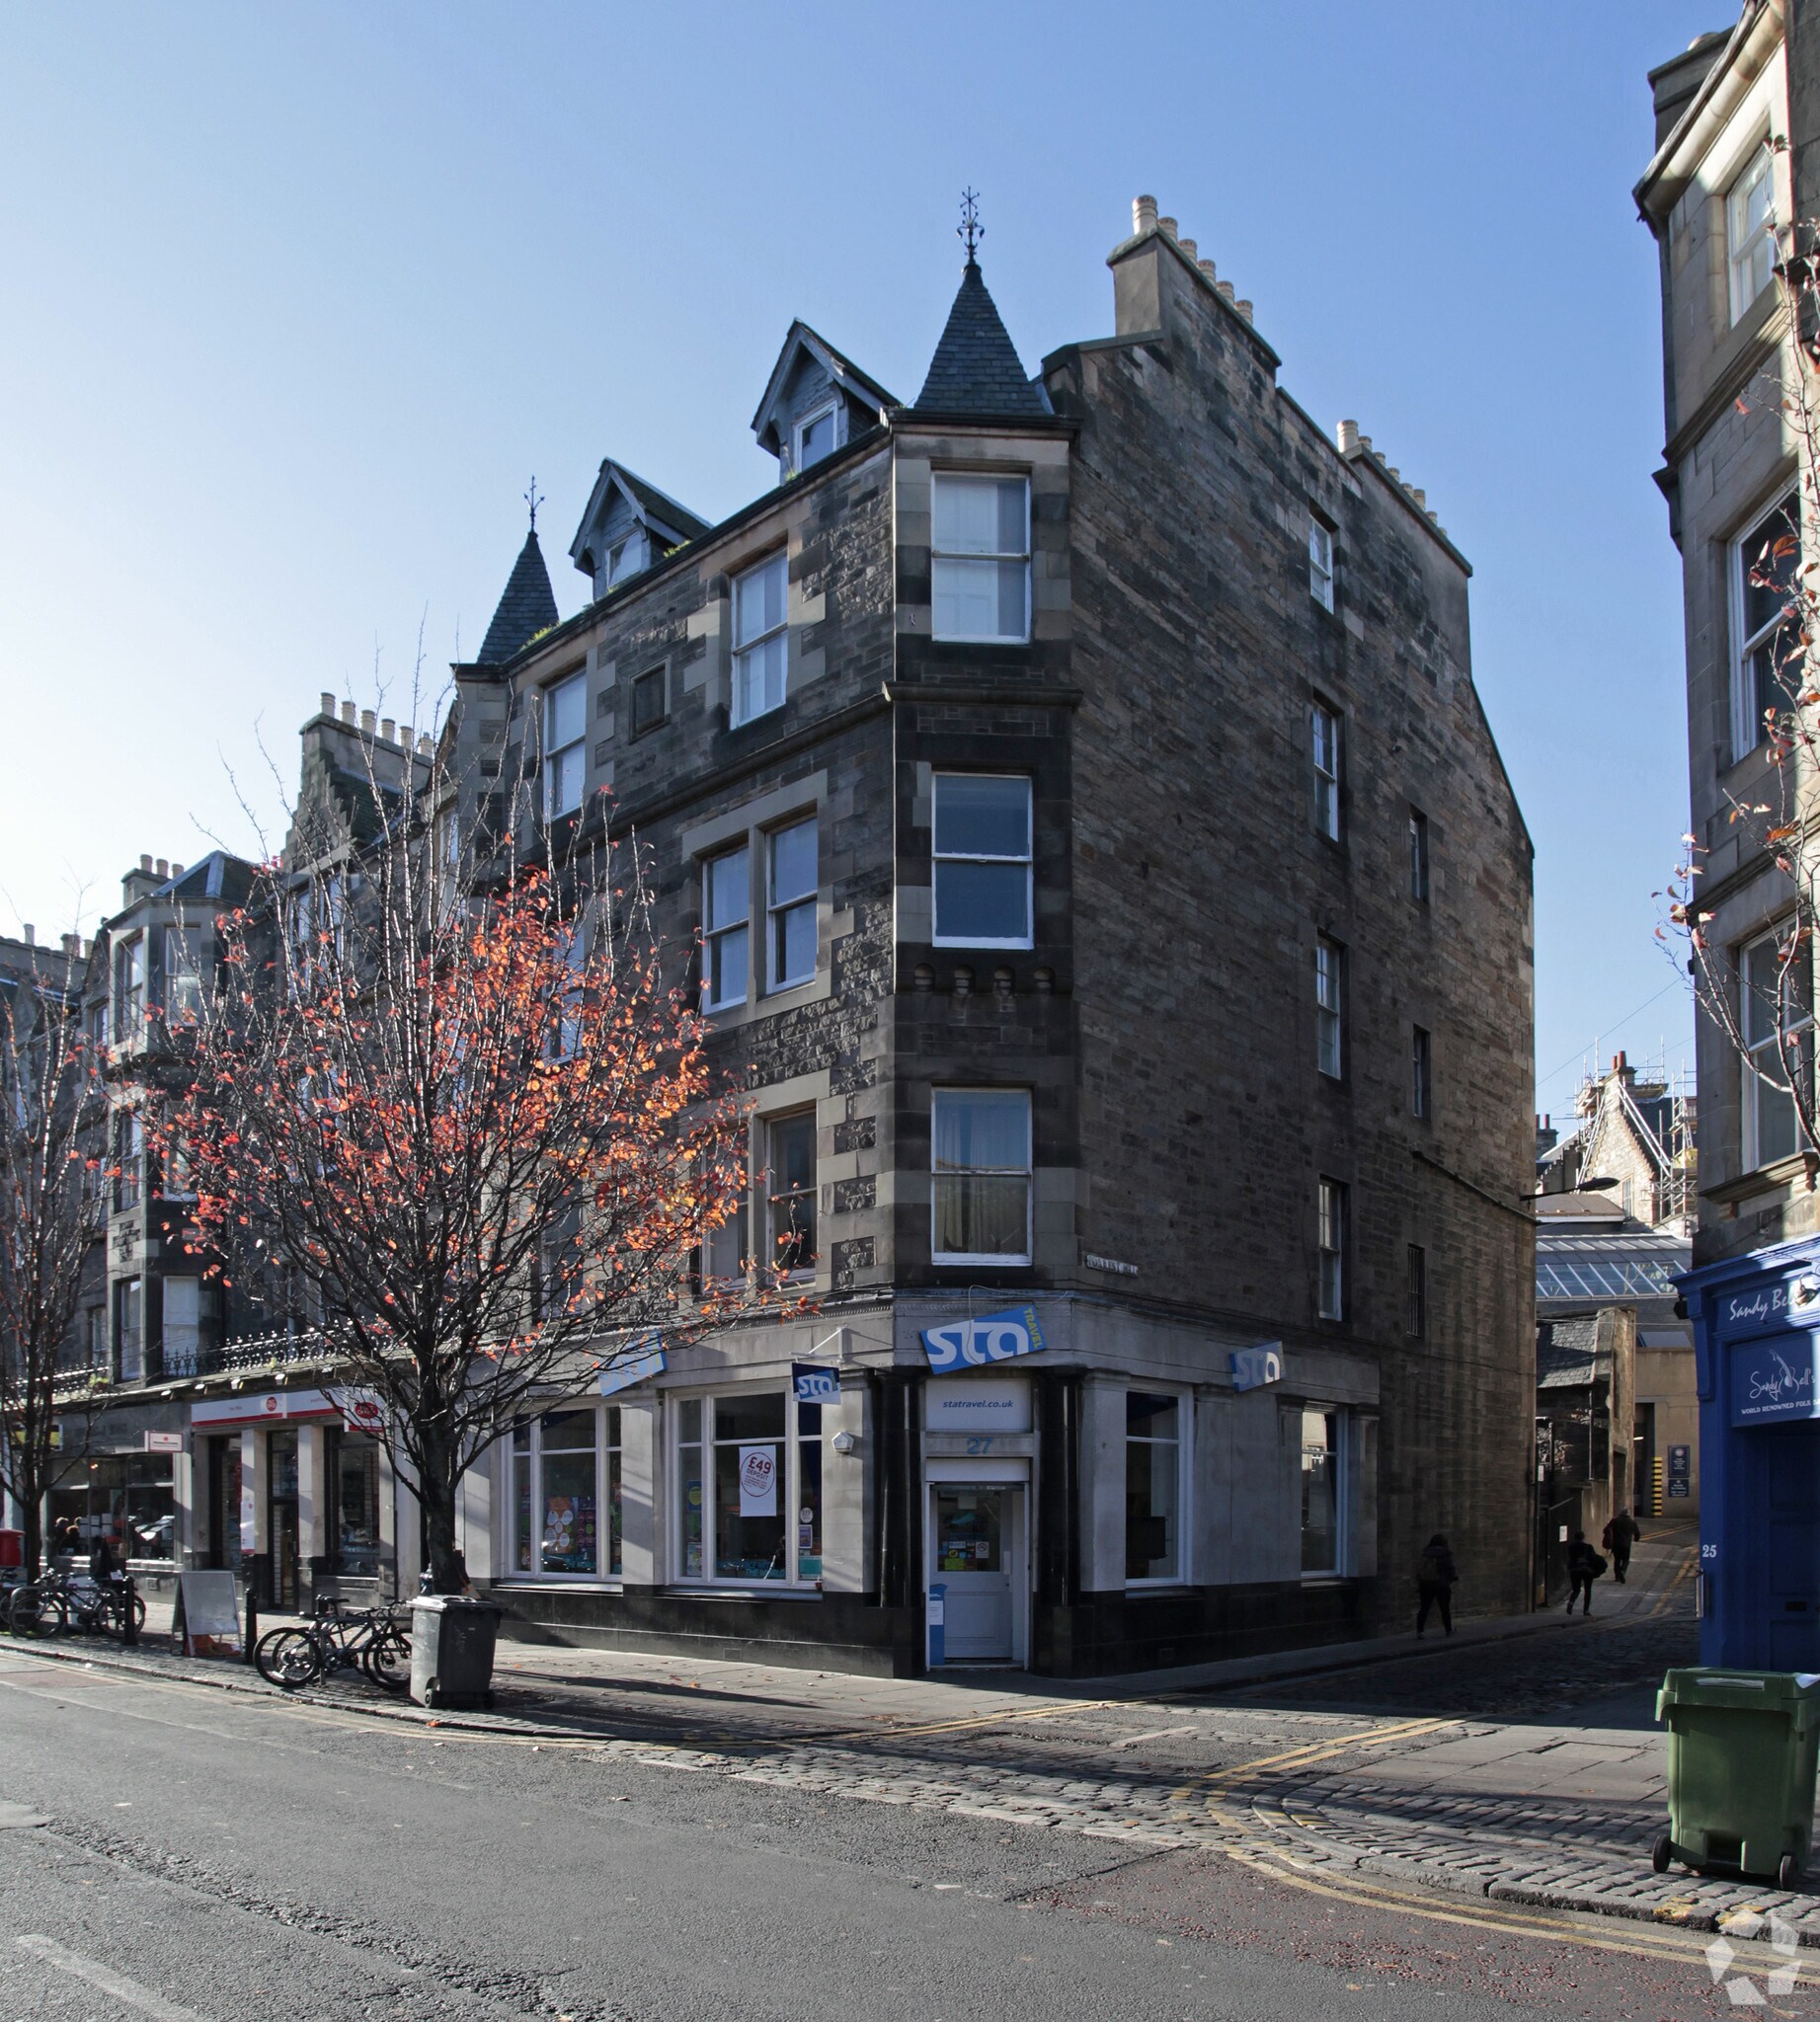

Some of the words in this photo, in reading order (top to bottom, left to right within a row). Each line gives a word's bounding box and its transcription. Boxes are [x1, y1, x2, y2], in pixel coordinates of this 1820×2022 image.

[1730, 1294, 1768, 1321] Sandy
[1023, 1307, 1044, 1349] TRAVEL
[926, 1320, 1029, 1364] sta
[798, 1373, 833, 1396] sta
[1749, 1370, 1780, 1402] Sandy
[942, 1399, 1014, 1409] statravel.co.uk
[1762, 1402, 1795, 1413] RENOWNED
[1795, 1399, 1812, 1408] FOLK
[966, 1438, 993, 1454] 27
[746, 1467, 769, 1481] DEPOSIT
[748, 1455, 772, 1474] £49
[1701, 1544, 1717, 1558] 25
